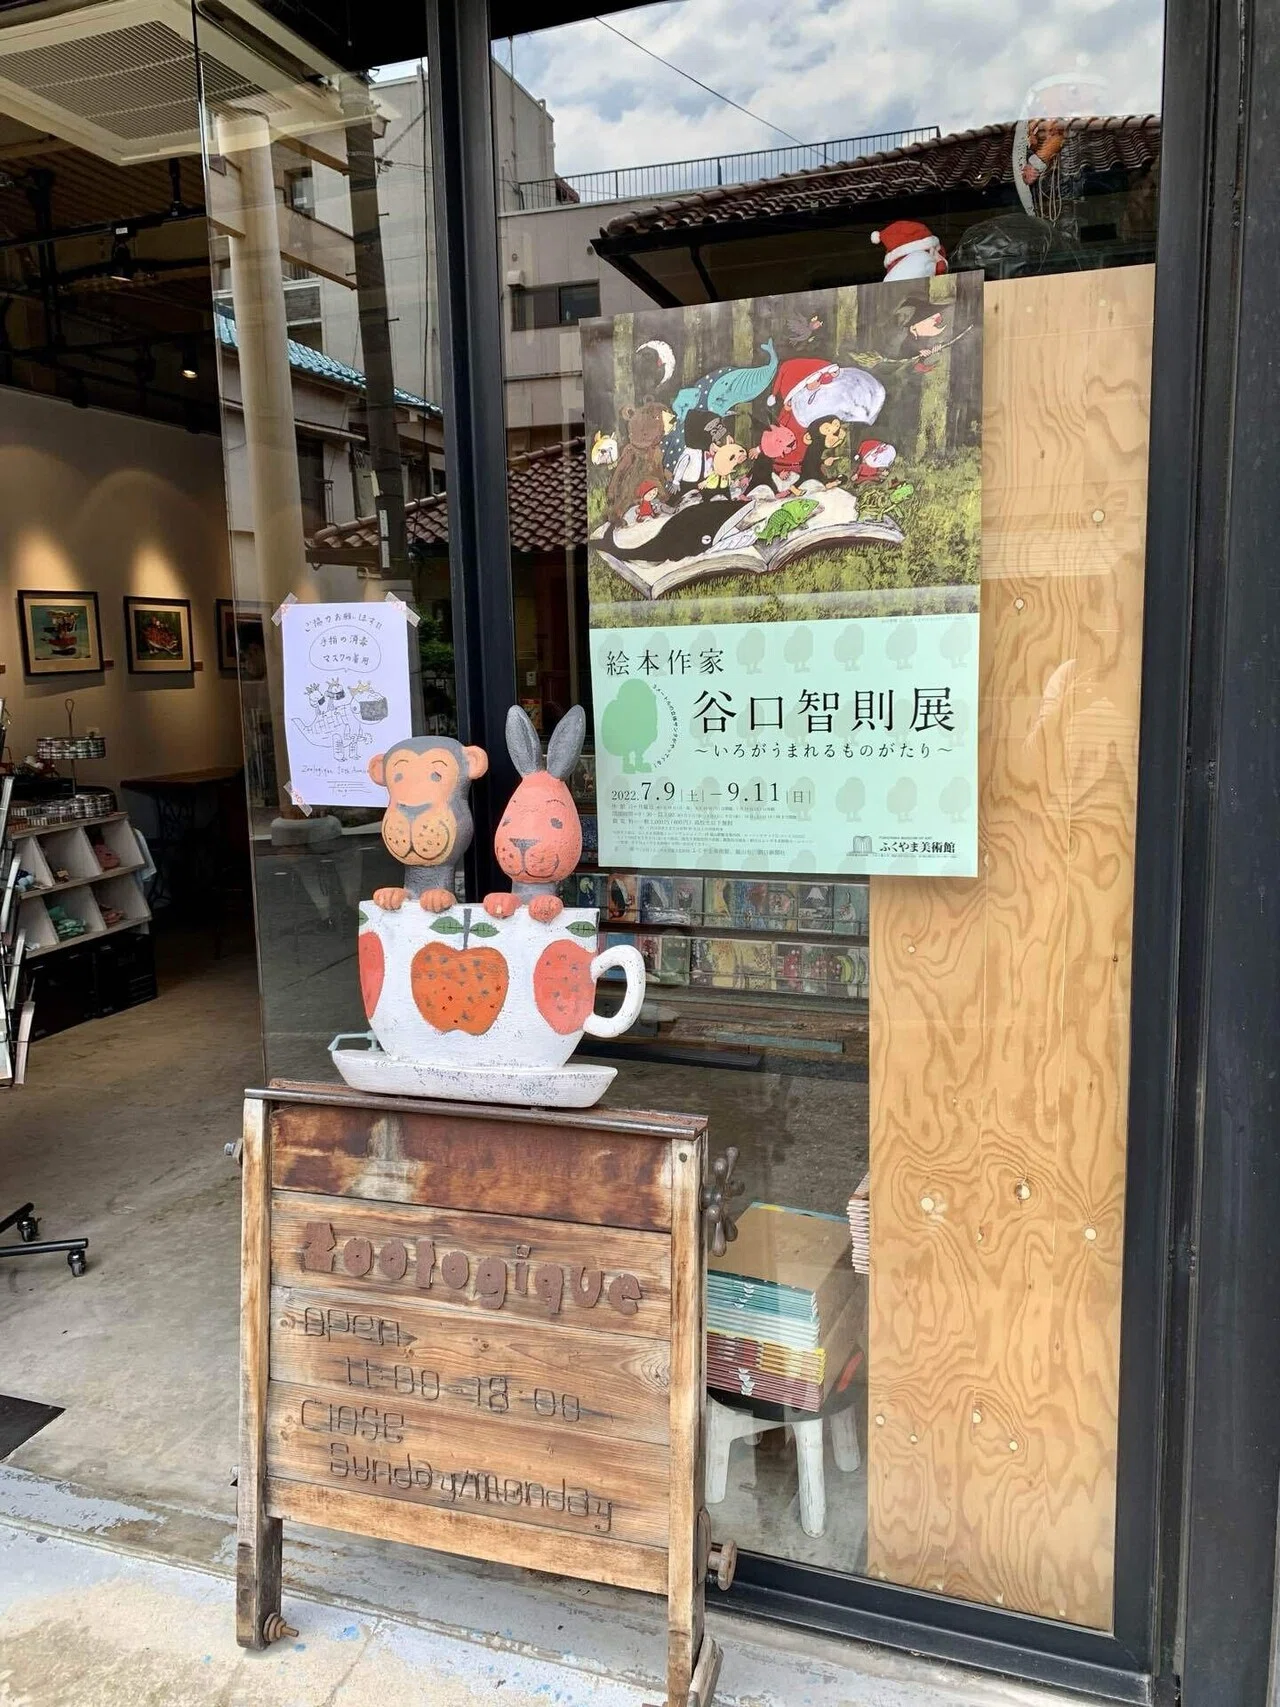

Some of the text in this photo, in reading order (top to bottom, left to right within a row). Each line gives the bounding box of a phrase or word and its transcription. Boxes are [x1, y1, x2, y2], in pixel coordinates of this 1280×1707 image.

[606, 648, 725, 676] 絵本作家
[692, 686, 956, 735] 谷口智則展
[879, 841, 956, 854] ふくやま美術館
